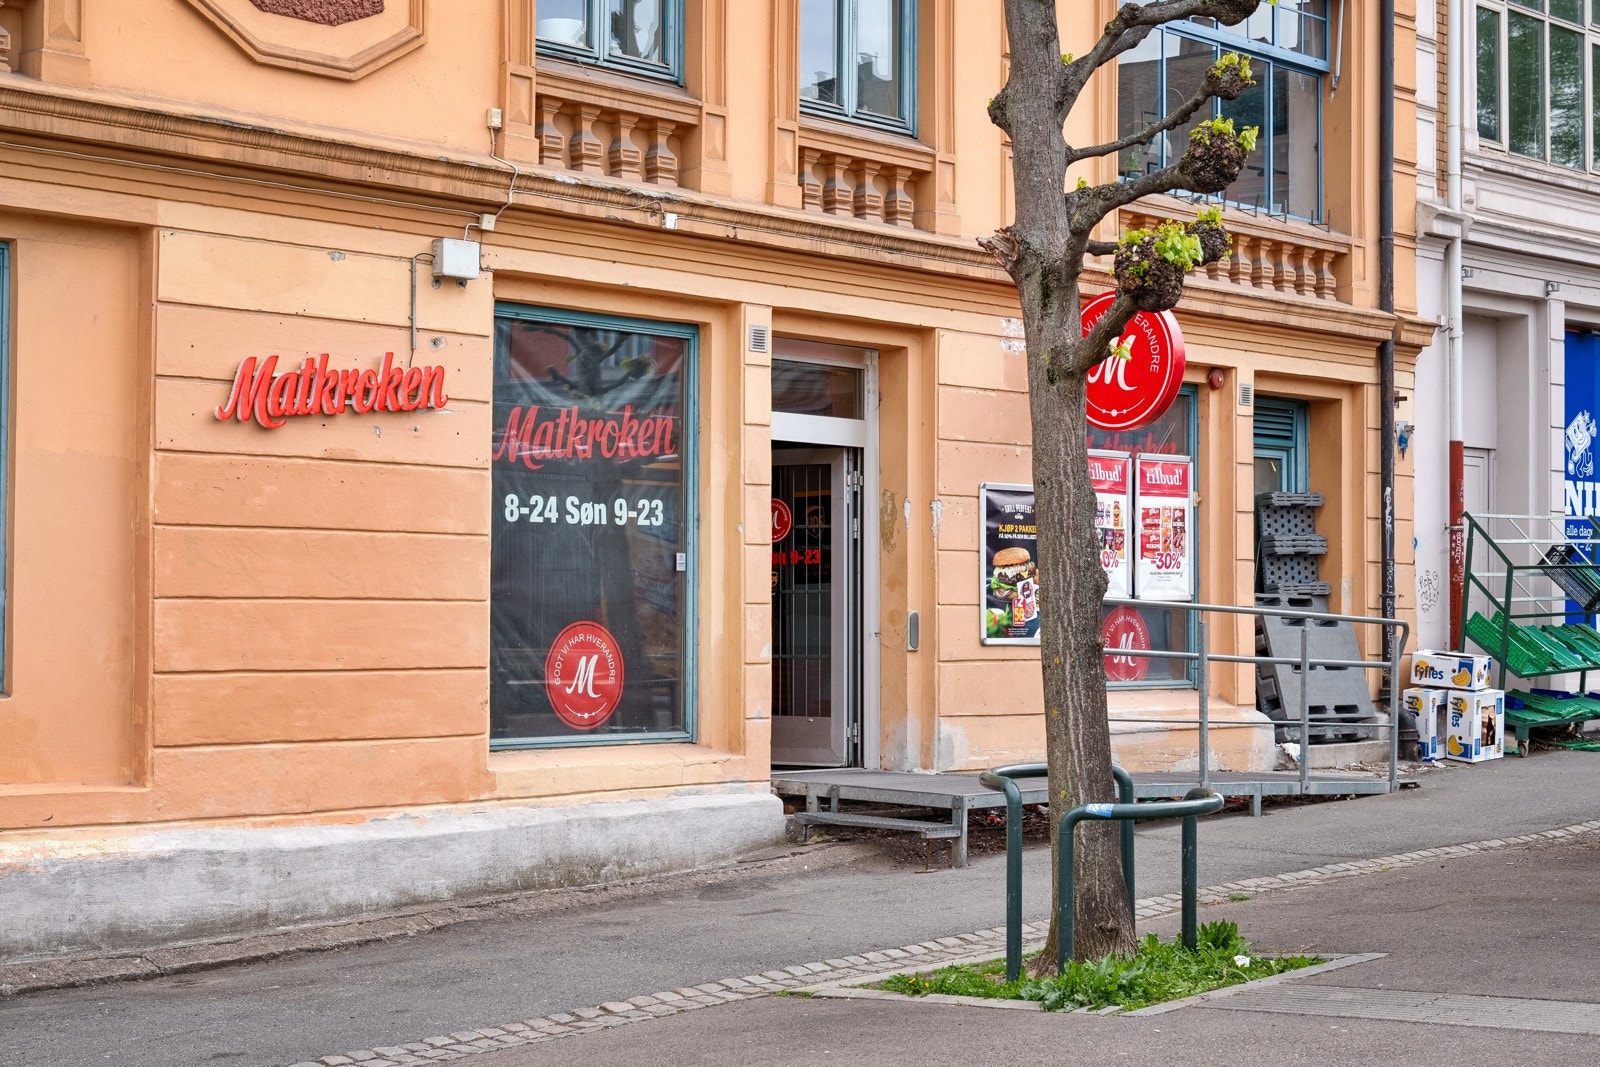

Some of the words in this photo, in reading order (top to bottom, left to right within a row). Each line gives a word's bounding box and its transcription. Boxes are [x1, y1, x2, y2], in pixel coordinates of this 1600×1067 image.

[1134, 313, 1160, 373] ERANDRE
[1087, 334, 1137, 391] M
[214, 351, 448, 429] Matkroken
[492, 404, 676, 470] Matkroken
[1146, 467, 1183, 486] tilbud!
[504, 494, 558, 524] 8-24
[565, 496, 607, 526] Søn
[614, 498, 664, 526] 9-23
[998, 524, 1014, 533] KJØP
[1014, 524, 1019, 533] 2
[1018, 524, 1037, 534] PAKKE
[1566, 524, 1578, 536] alle
[790, 549, 821, 565] 9-23
[1151, 552, 1181, 569] -30%
[1125, 614, 1146, 649] HVERANDR
[553, 655, 564, 685] GODT
[560, 645, 570, 655] VI
[568, 633, 585, 647] HAR
[586, 633, 616, 684] HVERANDRE
[1113, 632, 1136, 667] M
[565, 654, 602, 698] M
